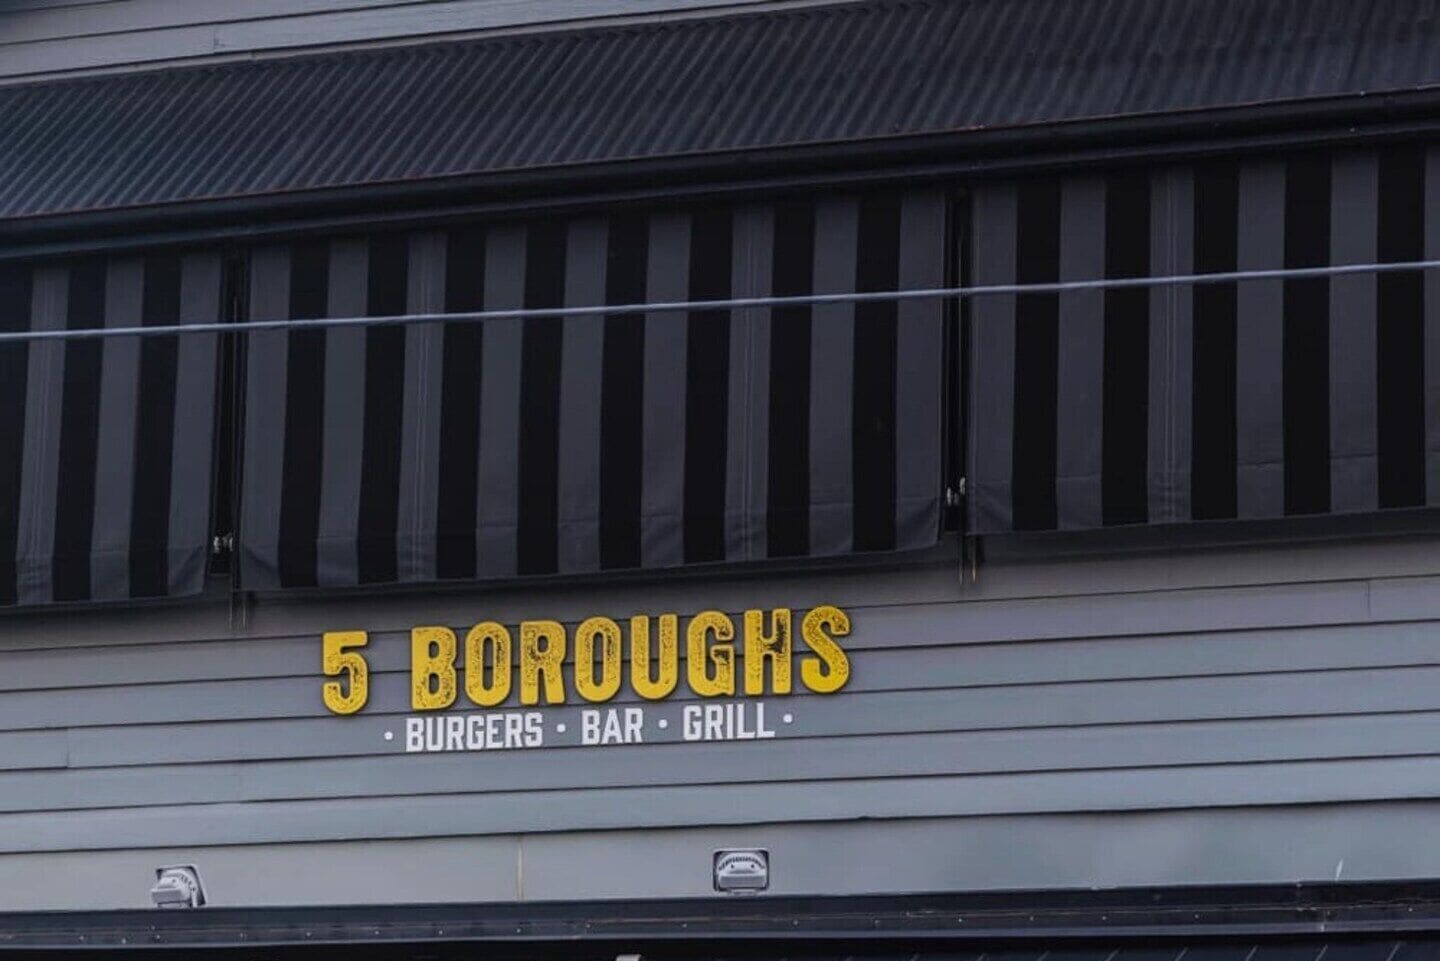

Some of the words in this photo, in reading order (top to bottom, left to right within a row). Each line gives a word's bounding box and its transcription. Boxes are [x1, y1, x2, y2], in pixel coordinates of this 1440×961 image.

[322, 630, 368, 715] 5
[411, 605, 851, 710] BOROUGHS
[405, 712, 544, 752] BURGERS
[581, 708, 643, 745] BAR
[683, 702, 776, 741] GRILL
